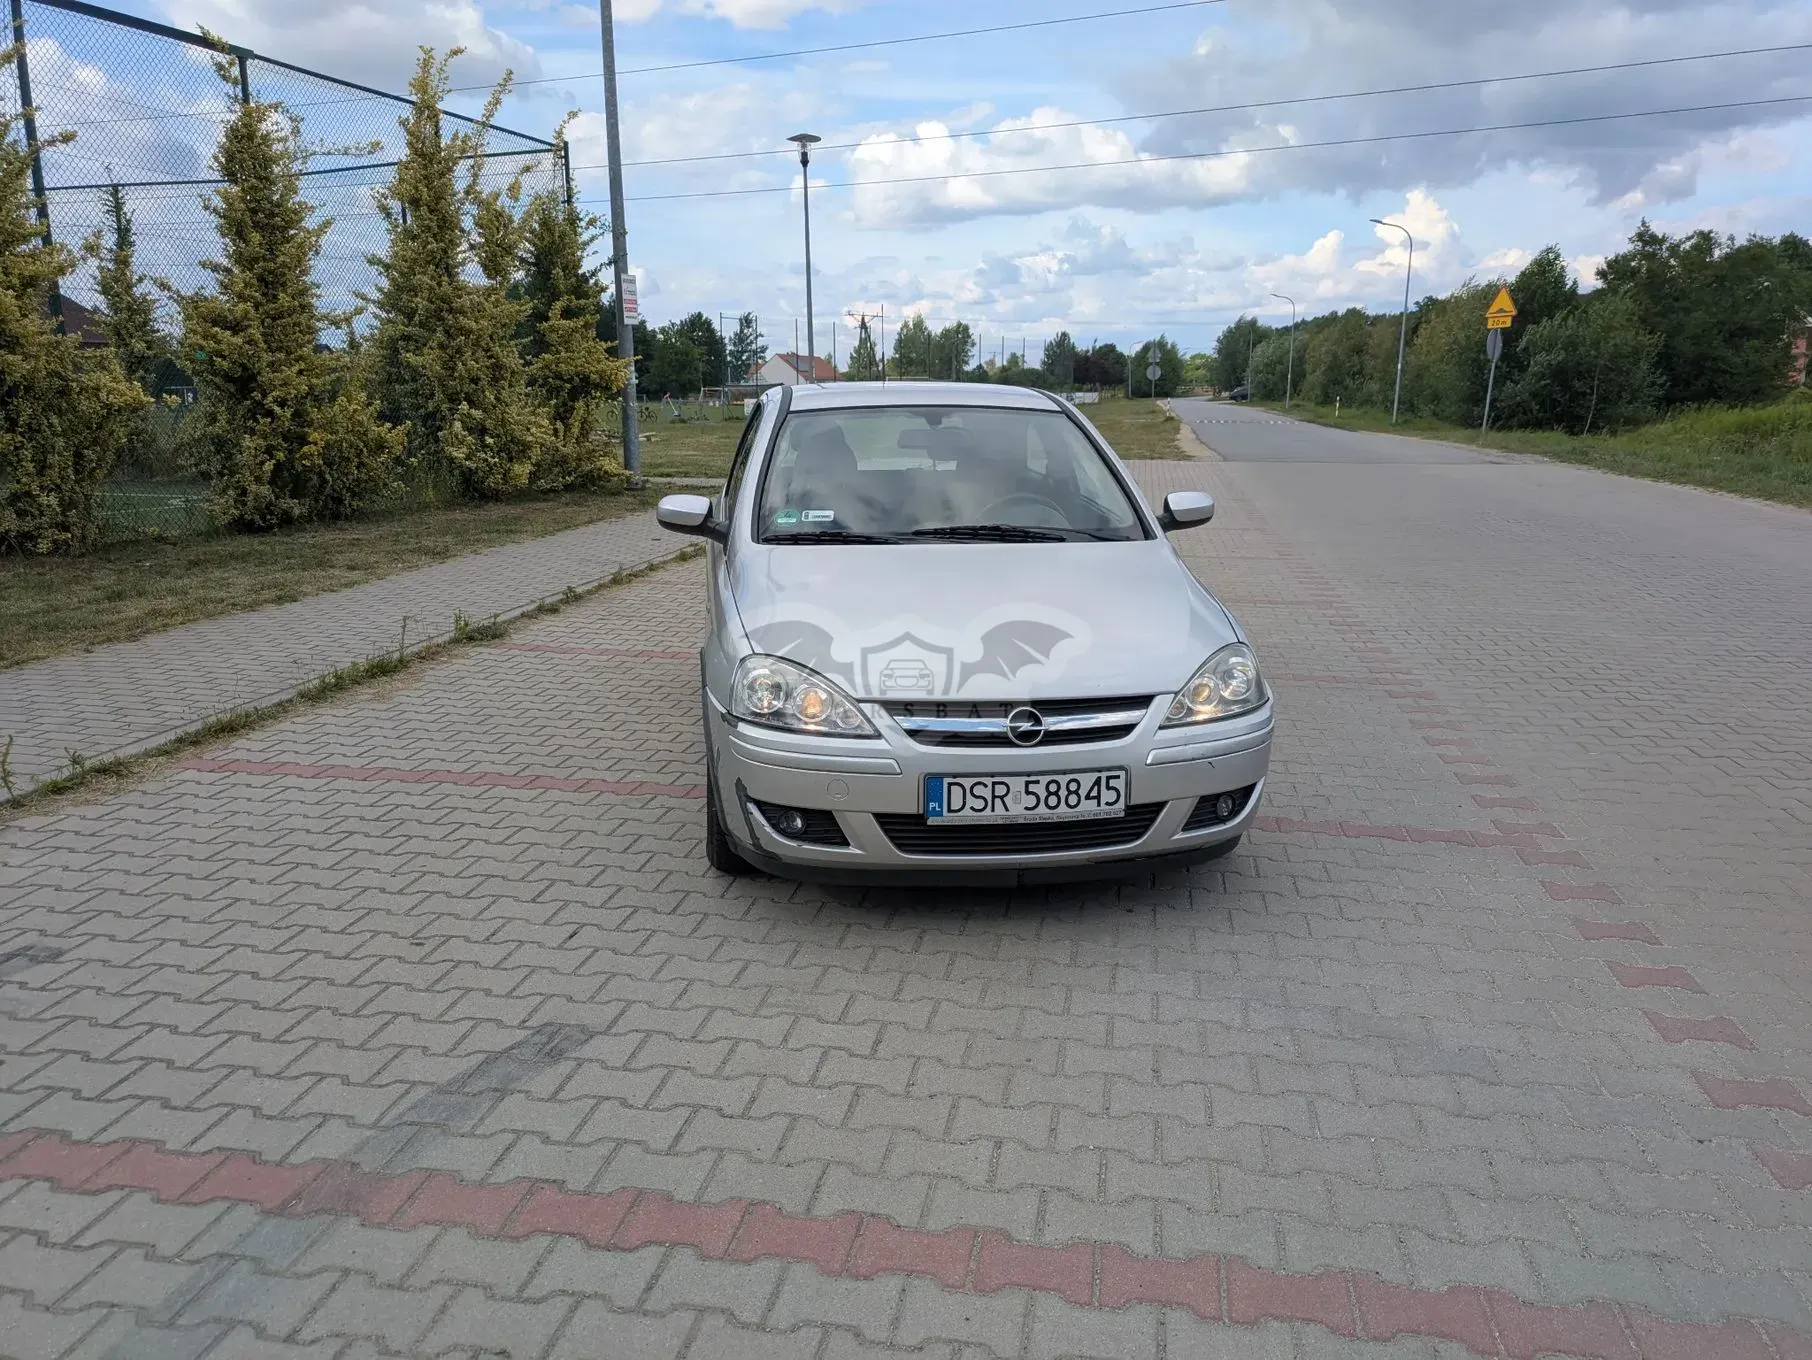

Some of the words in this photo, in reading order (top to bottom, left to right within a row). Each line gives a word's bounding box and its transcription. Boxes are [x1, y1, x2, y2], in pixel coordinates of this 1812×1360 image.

[929, 801, 942, 811] PL
[946, 780, 1011, 814] DSR
[1023, 774, 1121, 811] 58845
